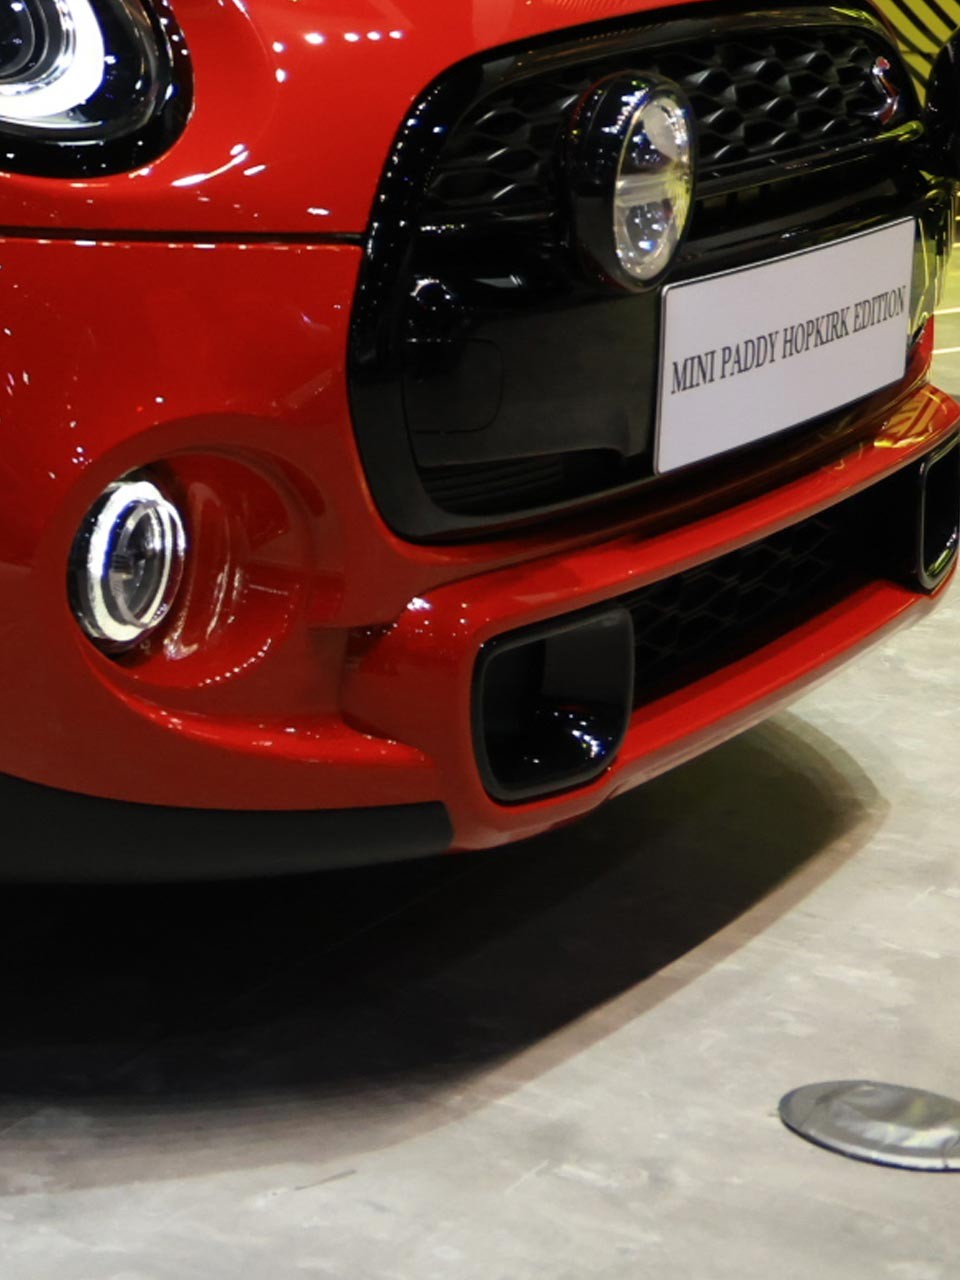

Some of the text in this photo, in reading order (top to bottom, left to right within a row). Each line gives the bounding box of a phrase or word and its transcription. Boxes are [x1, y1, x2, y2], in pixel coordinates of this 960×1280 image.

[670, 285, 907, 395] MINI PADDY HOPKIRK EDITION
